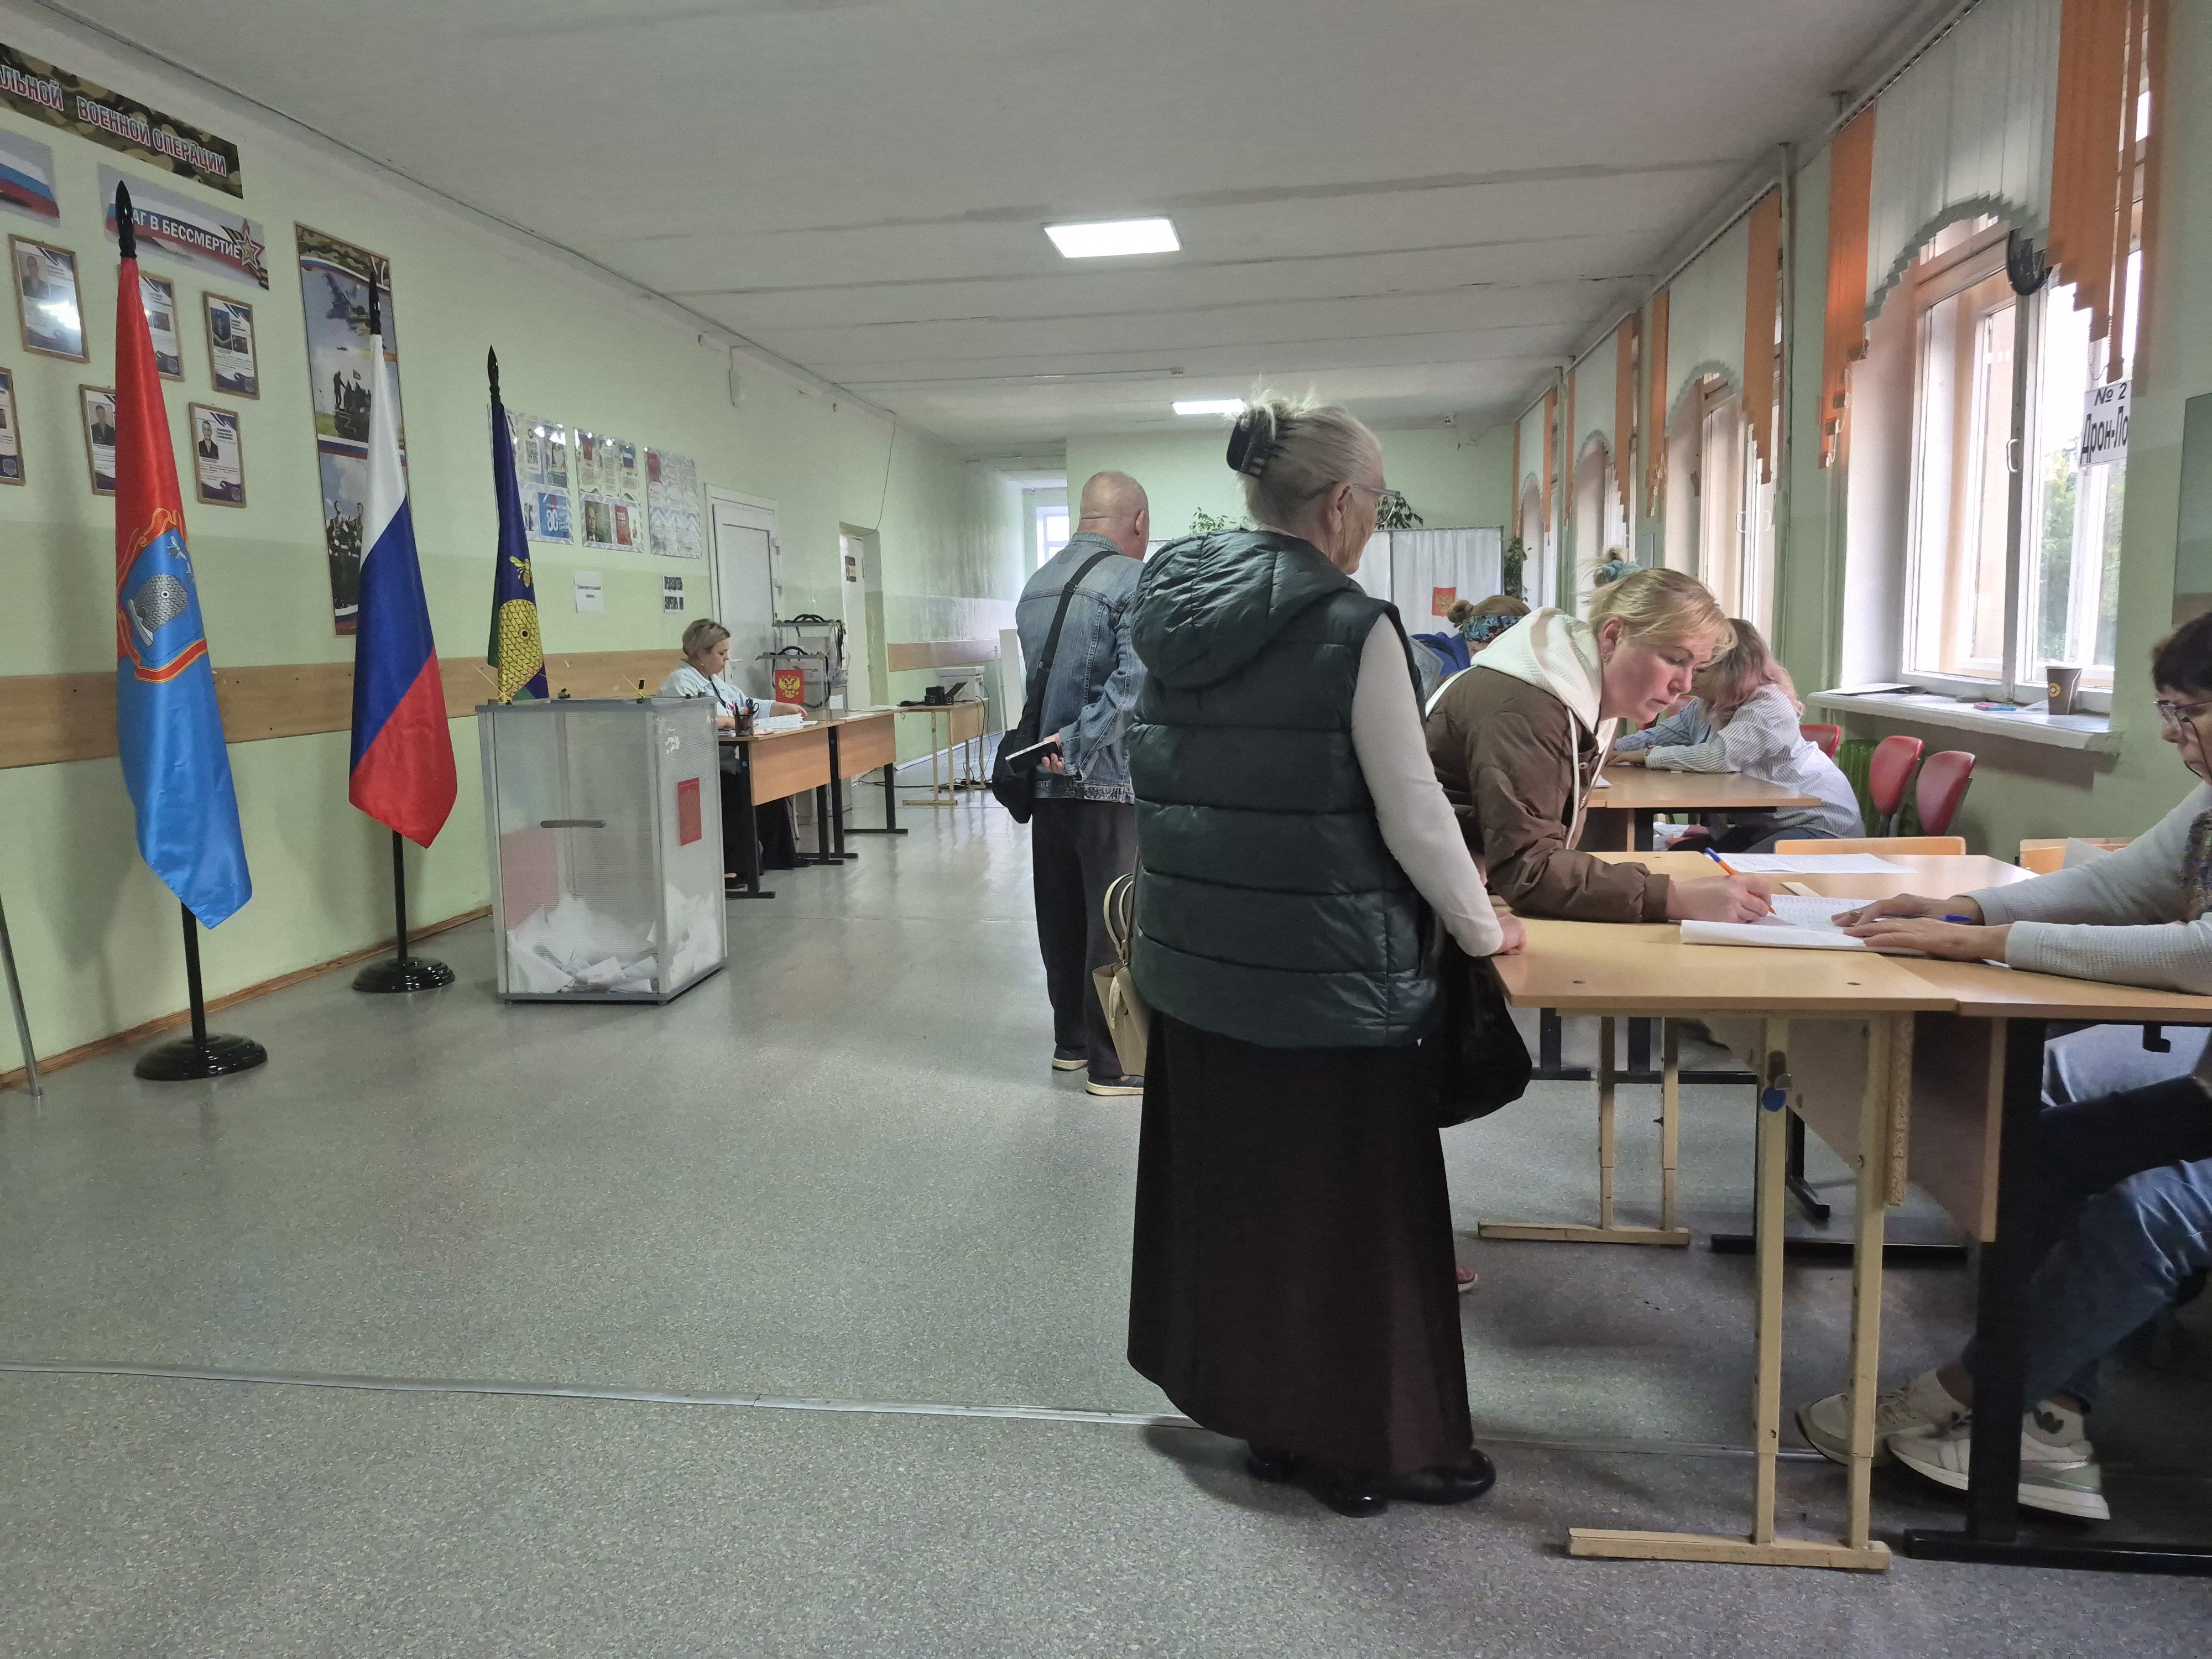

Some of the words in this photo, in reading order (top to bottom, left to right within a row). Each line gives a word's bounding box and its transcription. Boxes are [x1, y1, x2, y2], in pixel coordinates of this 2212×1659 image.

[76, 95, 150, 147] ВОЕННОЙ
[152, 128, 227, 177] ОПЕРАЦИИ
[132, 209, 147, 226] АГ
[150, 215, 159, 231] В
[163, 220, 241, 259] БЕССМЕРТИЕ
[2094, 387, 2114, 406] №
[2117, 382, 2127, 400] 2
[546, 509, 559, 532] 80
